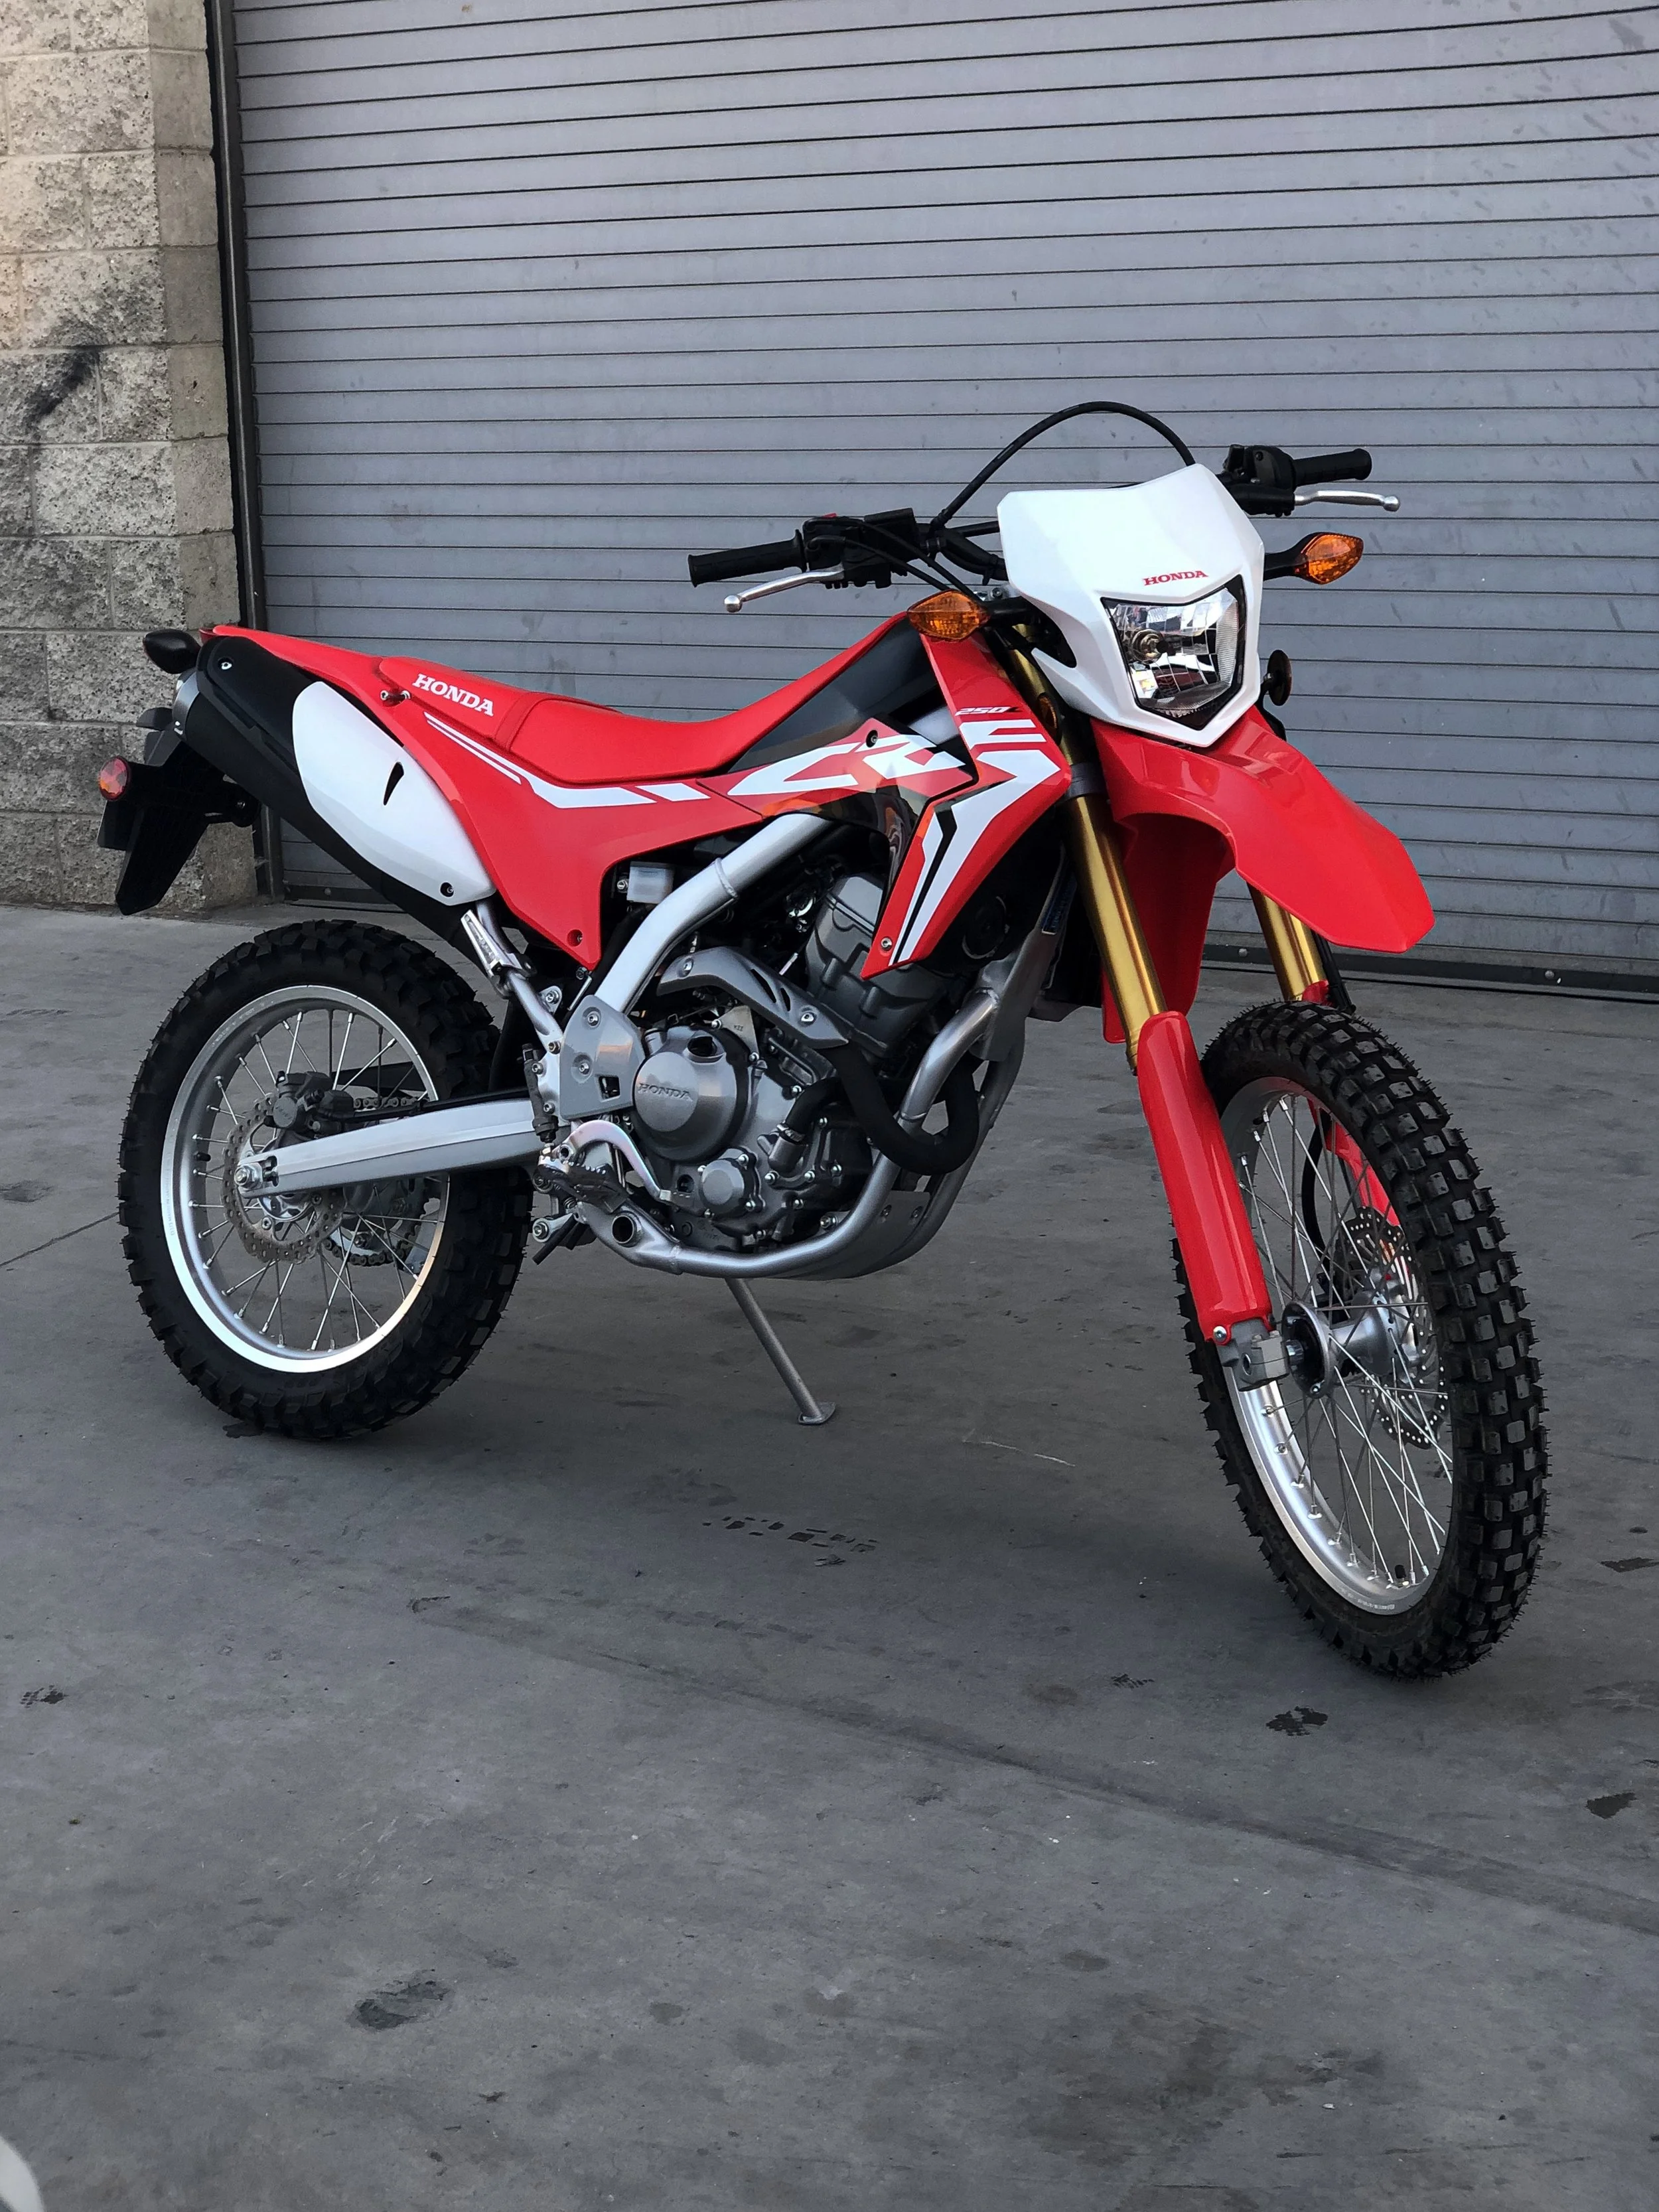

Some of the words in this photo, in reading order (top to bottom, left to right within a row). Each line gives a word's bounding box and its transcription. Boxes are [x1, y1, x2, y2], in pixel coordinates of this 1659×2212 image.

[1143, 570, 1208, 586] HONDA
[412, 673, 494, 717] HONDA
[638, 1082, 693, 1102] HONDA
